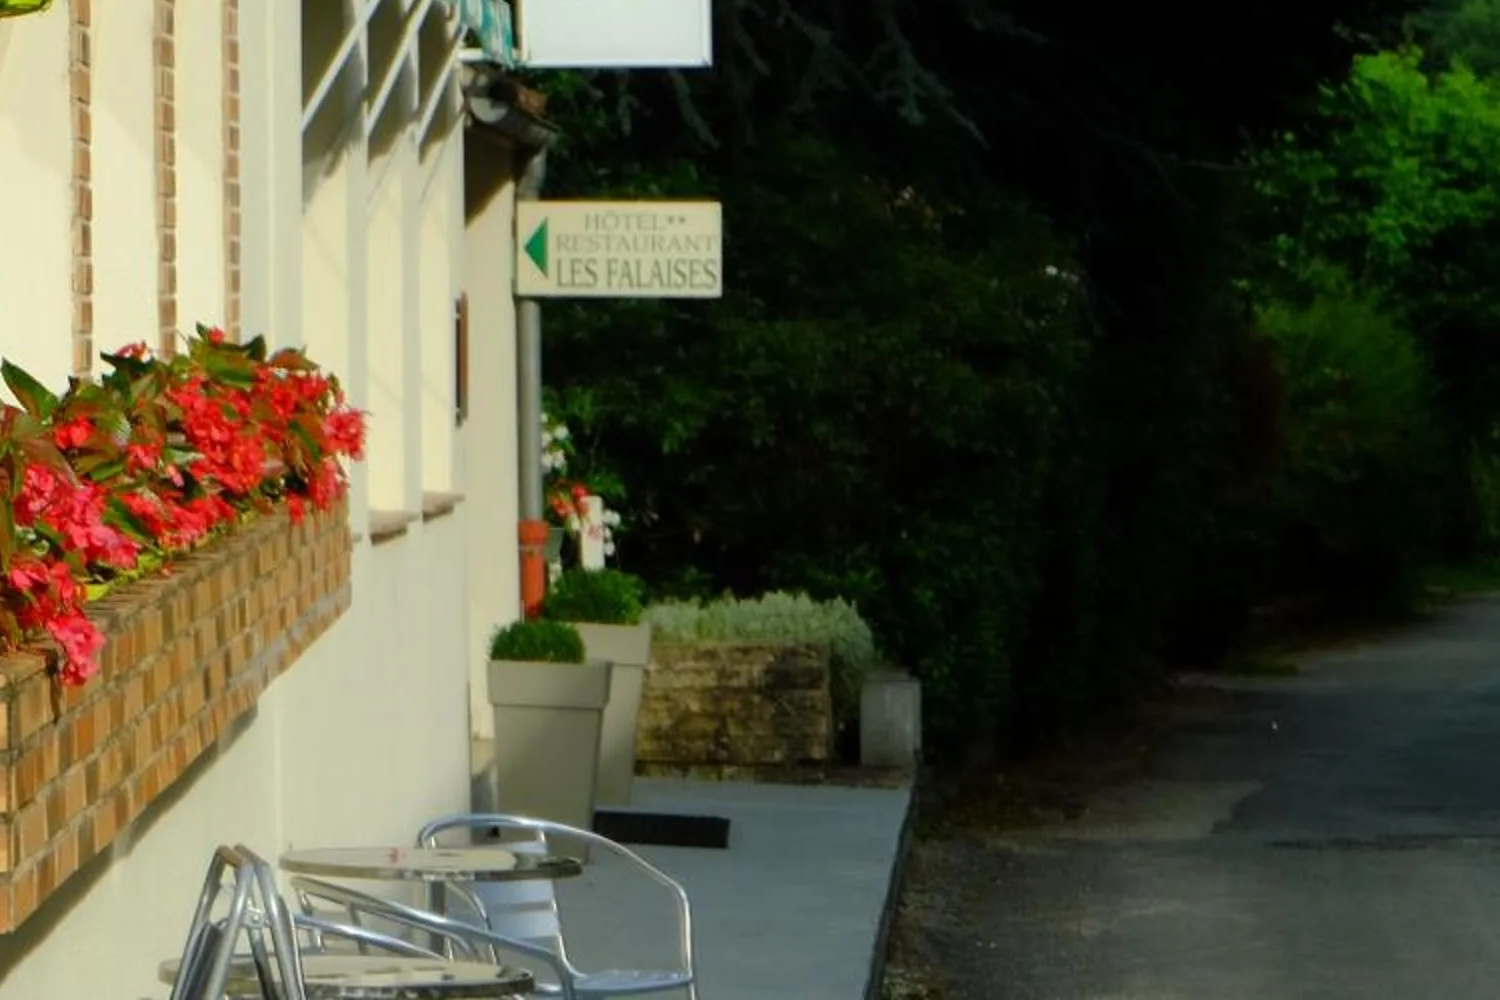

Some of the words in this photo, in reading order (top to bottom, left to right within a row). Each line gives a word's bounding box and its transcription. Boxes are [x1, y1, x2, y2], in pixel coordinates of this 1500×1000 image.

[556, 233, 714, 252] RESTAURANT
[556, 257, 598, 288] LES
[607, 257, 717, 289] FALAISES
